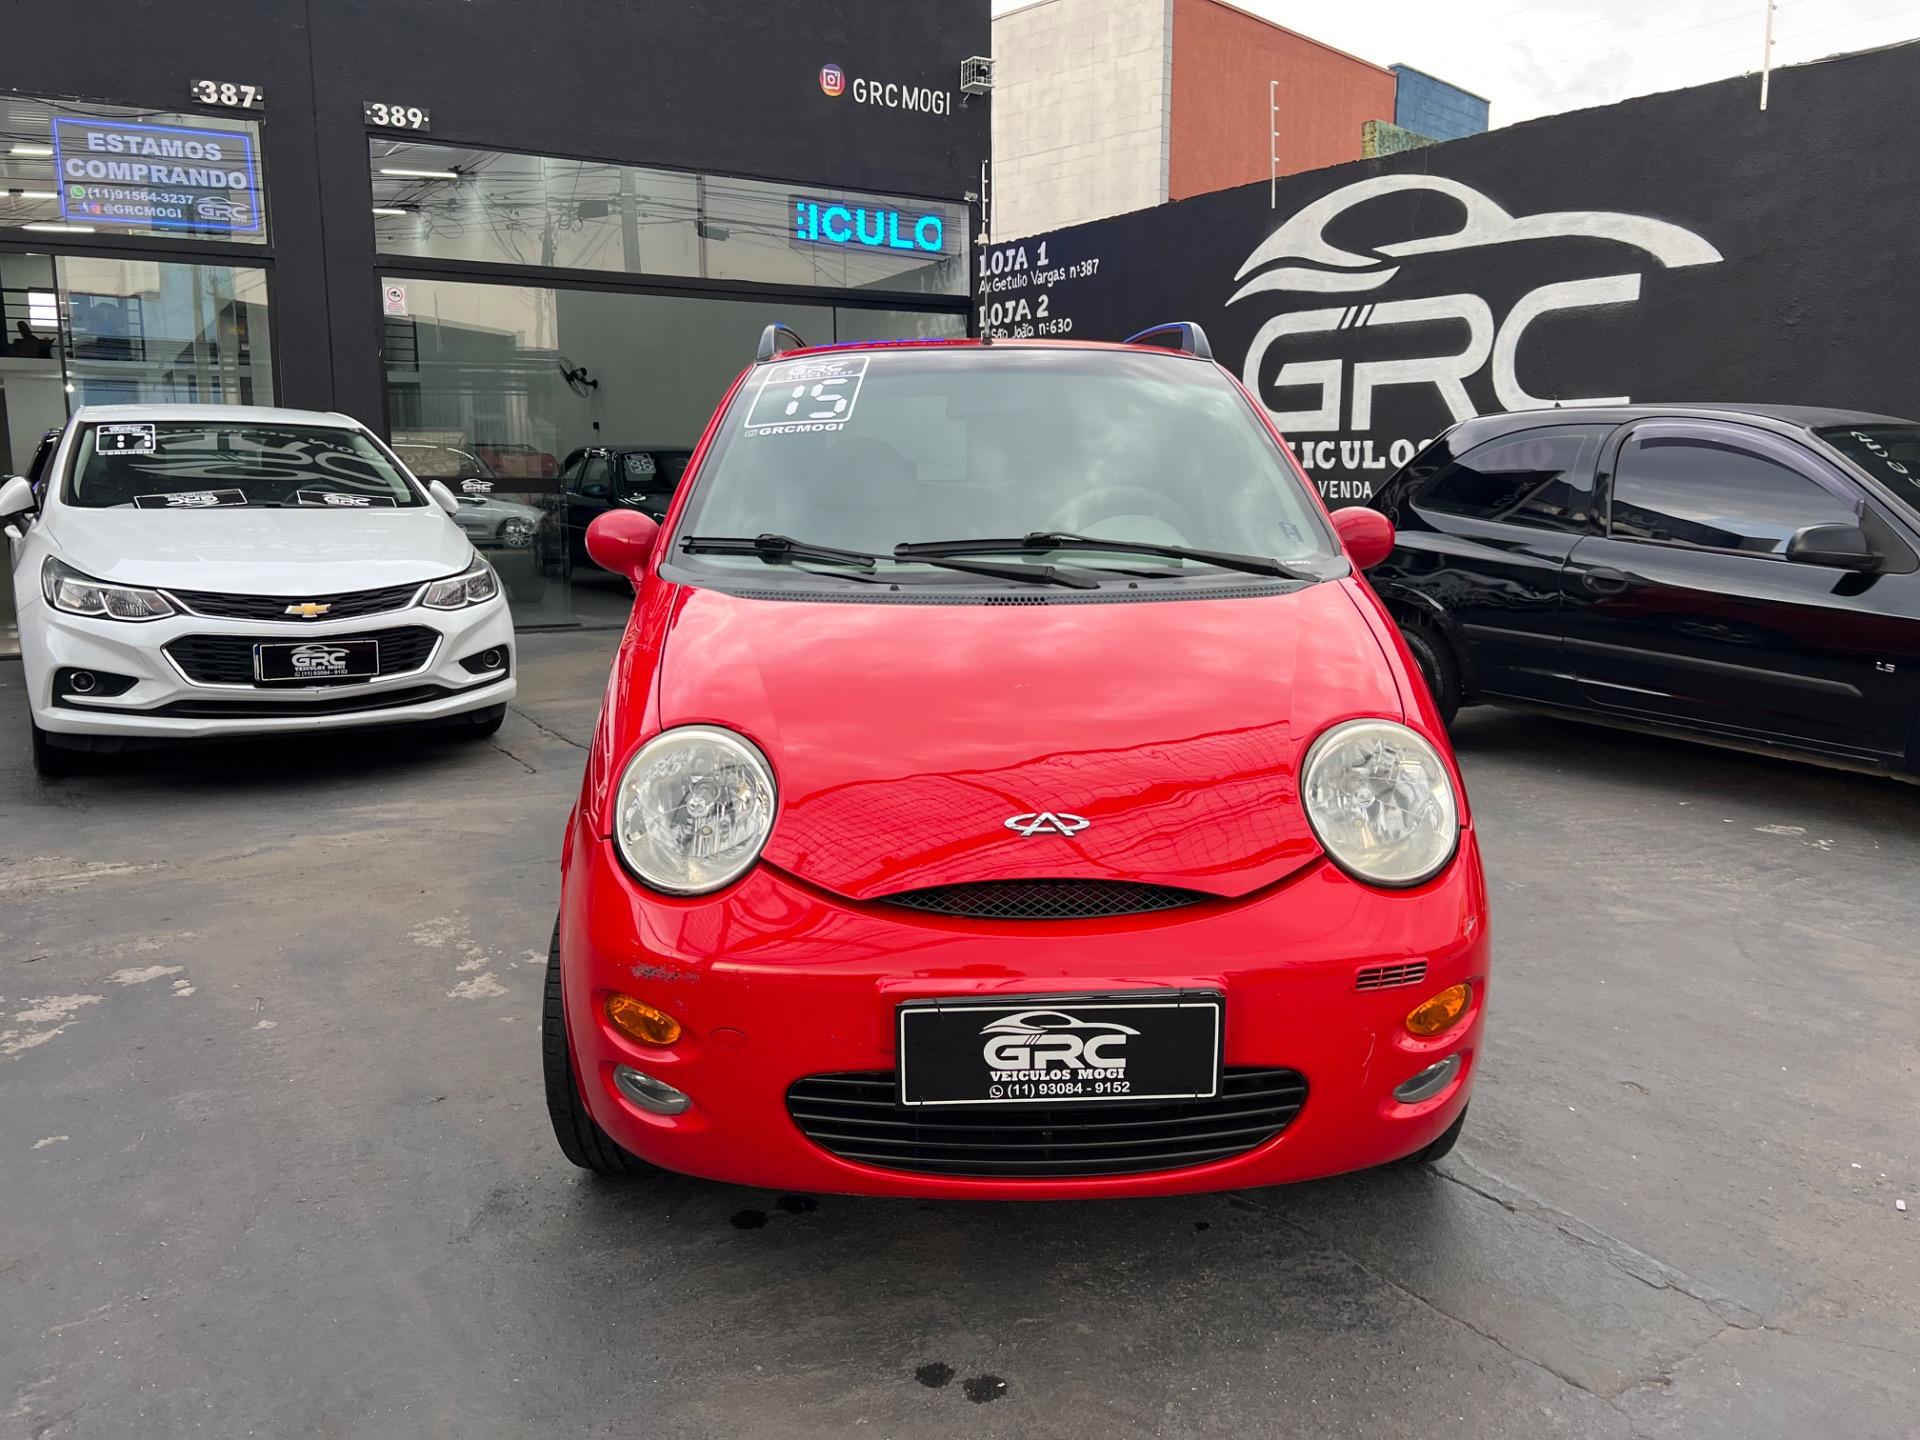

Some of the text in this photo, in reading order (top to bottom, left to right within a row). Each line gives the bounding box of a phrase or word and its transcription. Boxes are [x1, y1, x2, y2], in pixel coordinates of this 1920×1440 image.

[87, 132, 222, 161] ESTAMOS
[66, 158, 247, 190] COMPRANDO
[197, 203, 248, 221] GRC
[979, 246, 1028, 278] LOJA
[1037, 241, 1049, 267] 1
[979, 298, 1032, 328] LOJA
[1037, 294, 1049, 318] 2
[1242, 273, 1641, 431] GRC
[784, 379, 849, 419] 15
[1318, 480, 1374, 499] VENDA
[292, 652, 346, 666] GRC
[983, 1034, 1127, 1070] GRC
[989, 1068, 1125, 1082] VEICULOS MOGI
[1007, 1083, 1036, 1098] (11)
[1039, 1082, 1084, 1095] 93084
[1094, 1081, 1131, 1094] 9152
